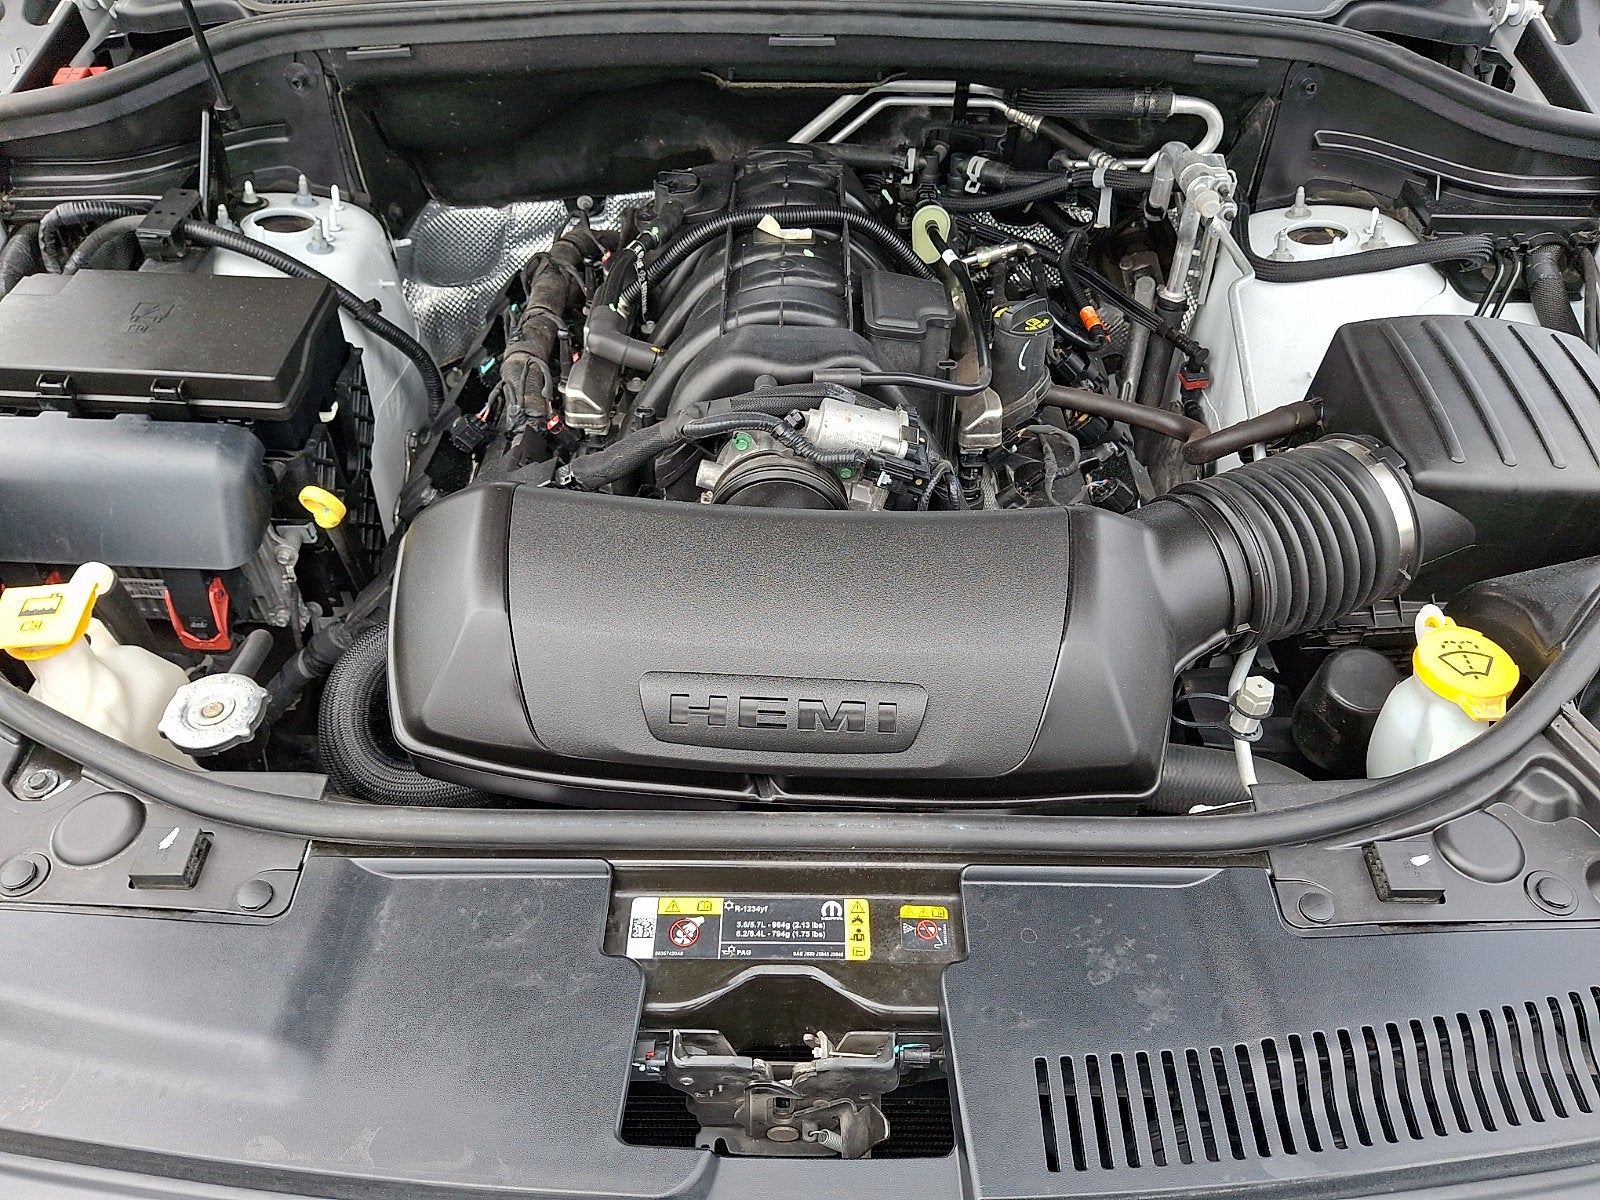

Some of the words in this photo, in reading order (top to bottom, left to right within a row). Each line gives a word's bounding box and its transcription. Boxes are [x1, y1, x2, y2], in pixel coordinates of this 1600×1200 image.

[669, 693, 898, 734] HEMI
[734, 905, 768, 914] R-1234yf
[736, 921, 766, 929] 3.6/5.7L
[792, 922, 810, 930] (2.13
[811, 922, 826, 930] lbs)
[792, 931, 810, 939] (1.75
[811, 931, 826, 939] lbs)
